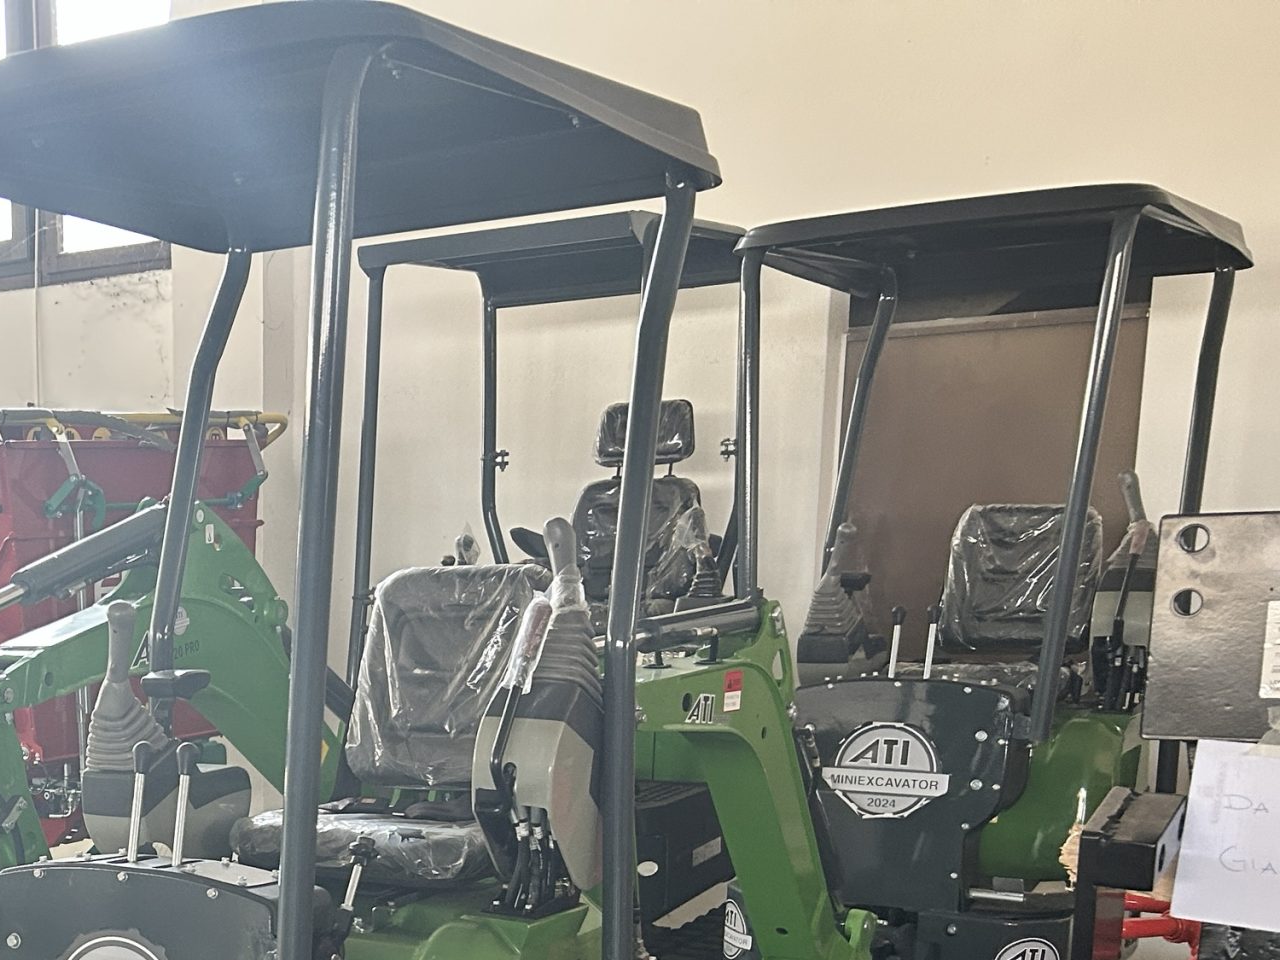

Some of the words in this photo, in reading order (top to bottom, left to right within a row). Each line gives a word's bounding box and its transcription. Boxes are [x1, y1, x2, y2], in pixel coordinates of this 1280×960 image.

[685, 693, 716, 724] ATI
[847, 737, 912, 767] ATI
[830, 773, 939, 791] MINIEXCAVATOR
[866, 797, 896, 808] 2024
